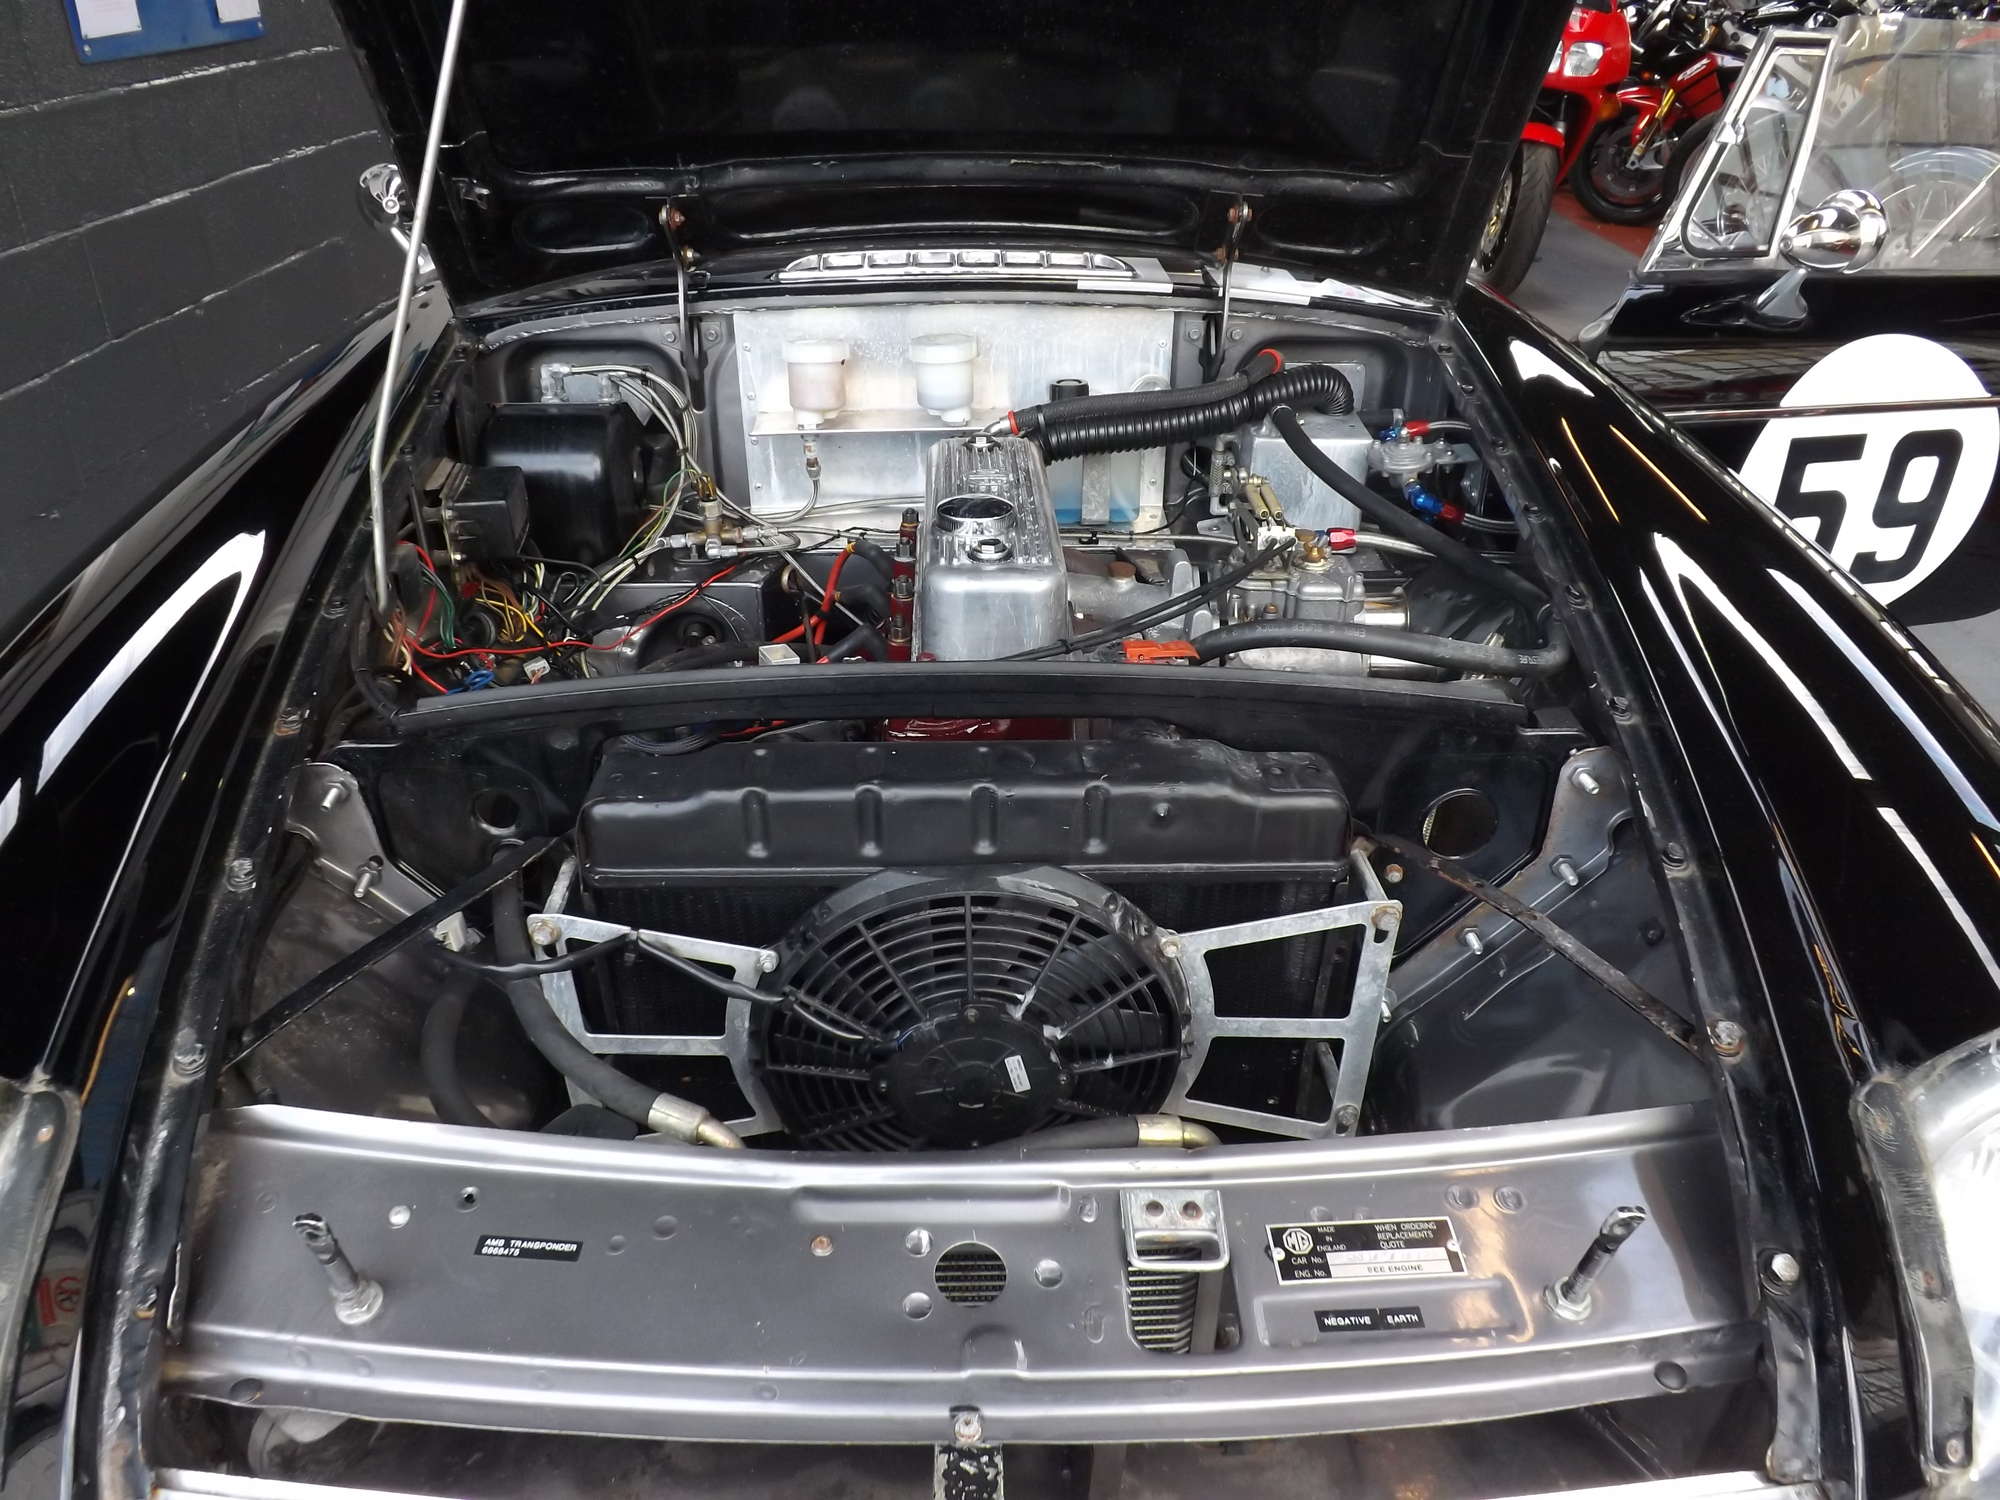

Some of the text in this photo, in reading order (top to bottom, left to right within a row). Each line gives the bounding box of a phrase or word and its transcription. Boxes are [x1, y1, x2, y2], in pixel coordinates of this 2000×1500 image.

[1774, 428, 1963, 584] 59
[1375, 1222, 1437, 1232] WHEN ORDERING
[1377, 1230, 1434, 1240] REPLACEMENTS
[510, 1239, 577, 1252] TRANSPONDER
[1285, 1232, 1310, 1252] MG
[1380, 1241, 1405, 1249] QUOTE
[1316, 1244, 1347, 1252] ENGLAND
[1291, 1257, 1308, 1265] CAR
[1388, 1264, 1423, 1272] ENGINE
[1324, 1314, 1419, 1326] NEGATIVE EARTH
